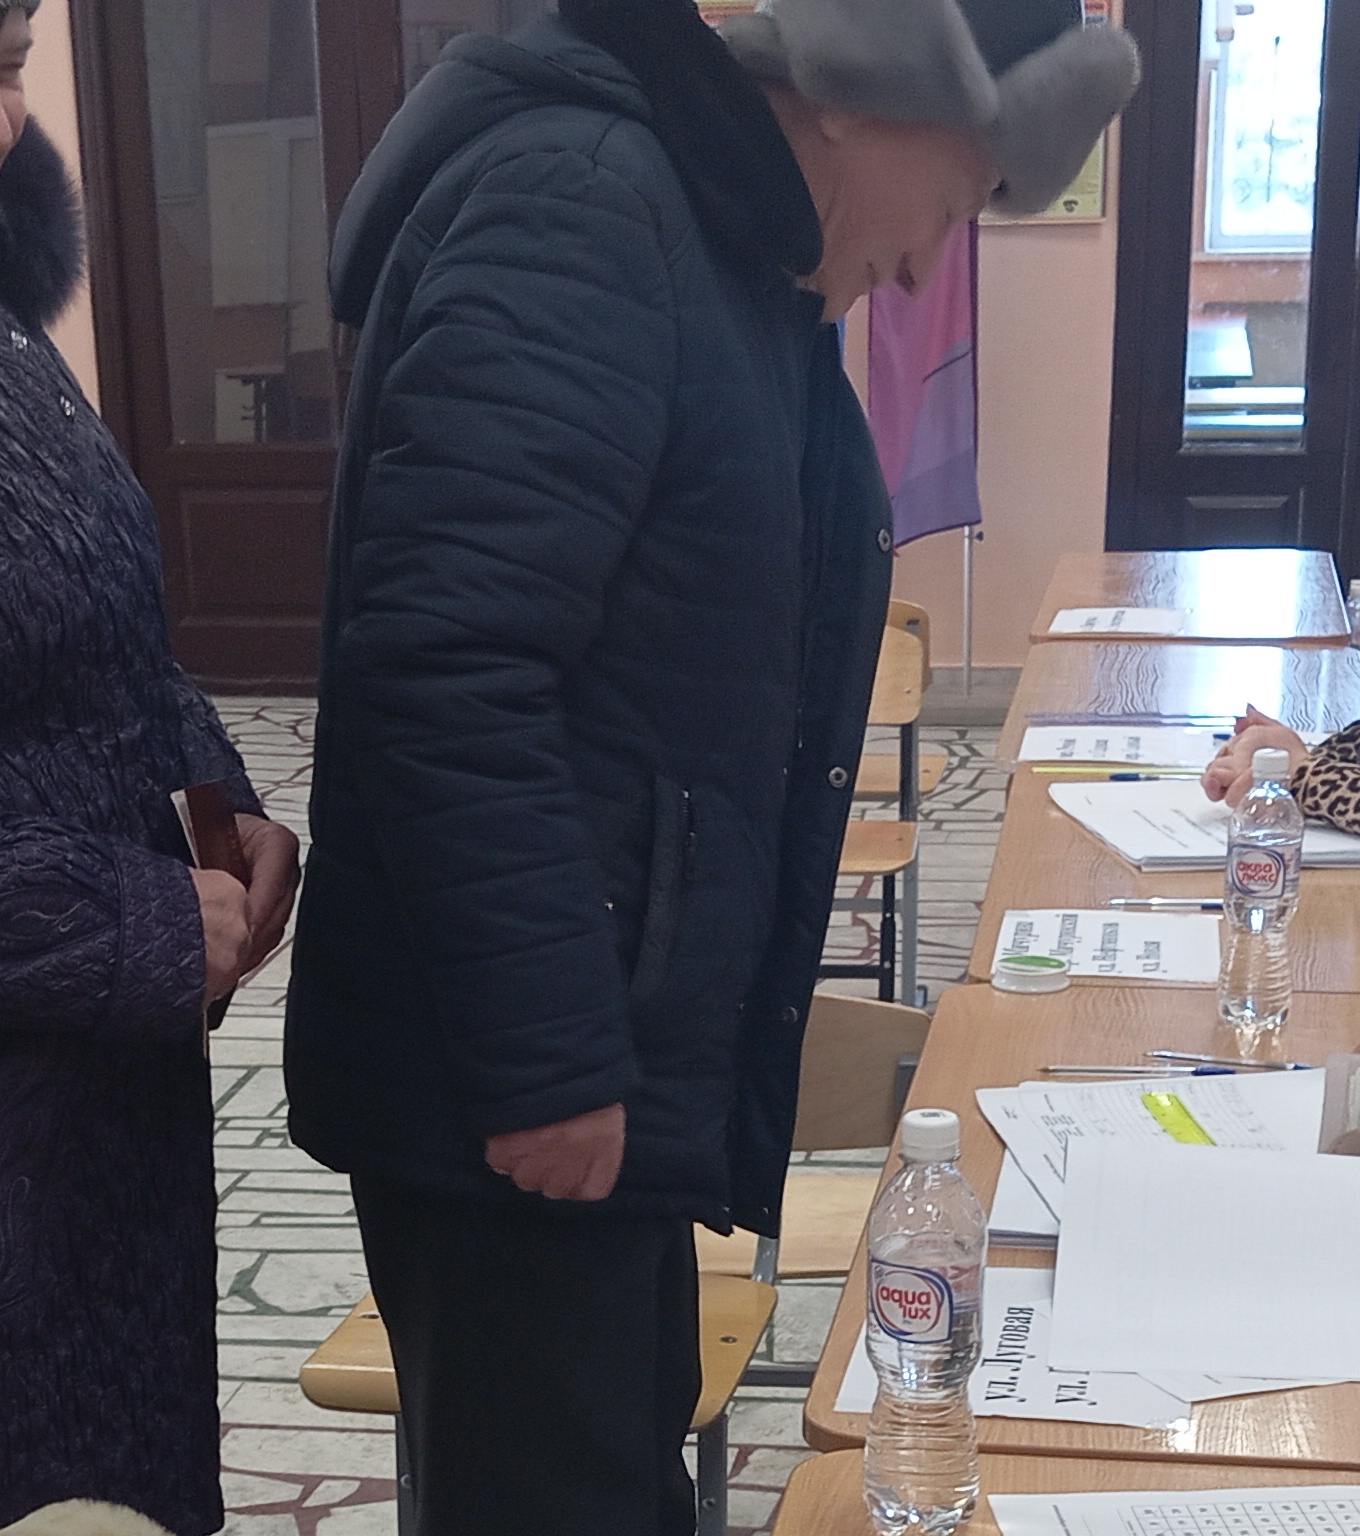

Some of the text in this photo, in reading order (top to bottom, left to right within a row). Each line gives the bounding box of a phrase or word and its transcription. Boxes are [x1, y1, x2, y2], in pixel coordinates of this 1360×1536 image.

[879, 1286, 932, 1310] aqua
[901, 1303, 932, 1320] lux
[980, 1306, 1036, 1402] ул. Луговая
[1054, 1381, 1097, 1406] ул.
